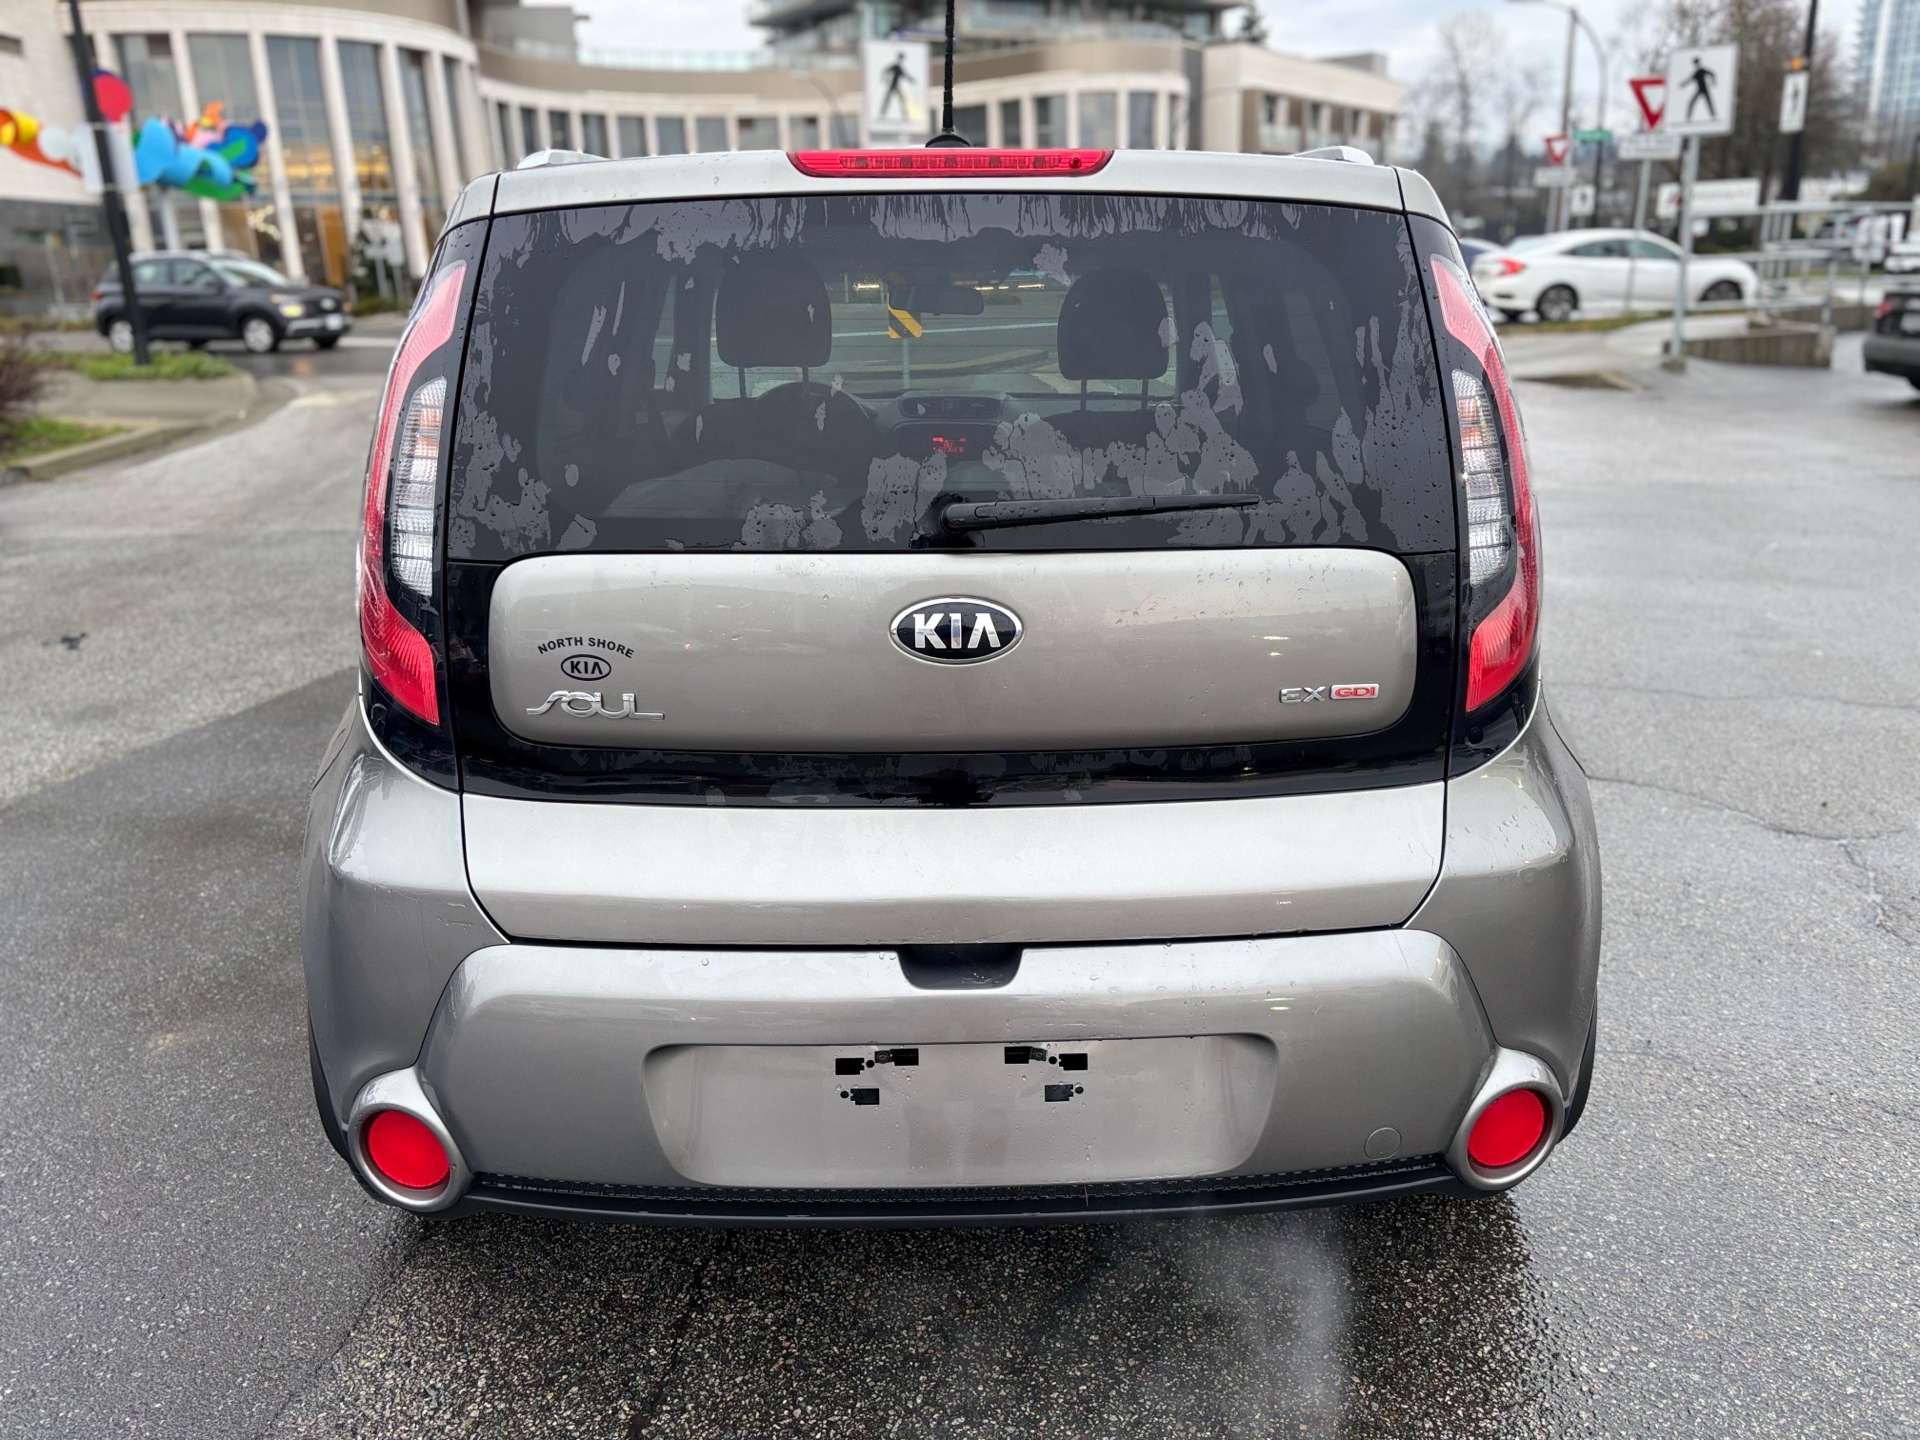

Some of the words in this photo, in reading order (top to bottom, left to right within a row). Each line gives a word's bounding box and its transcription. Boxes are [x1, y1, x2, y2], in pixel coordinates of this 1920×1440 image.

[912, 612, 1001, 650] KIA
[537, 636, 583, 655] NORTH
[588, 637, 635, 659] SHORE
[570, 660, 604, 675] KIA
[526, 690, 665, 721] SOUL
[1279, 685, 1326, 704] EX
[1334, 686, 1376, 698] GDI
